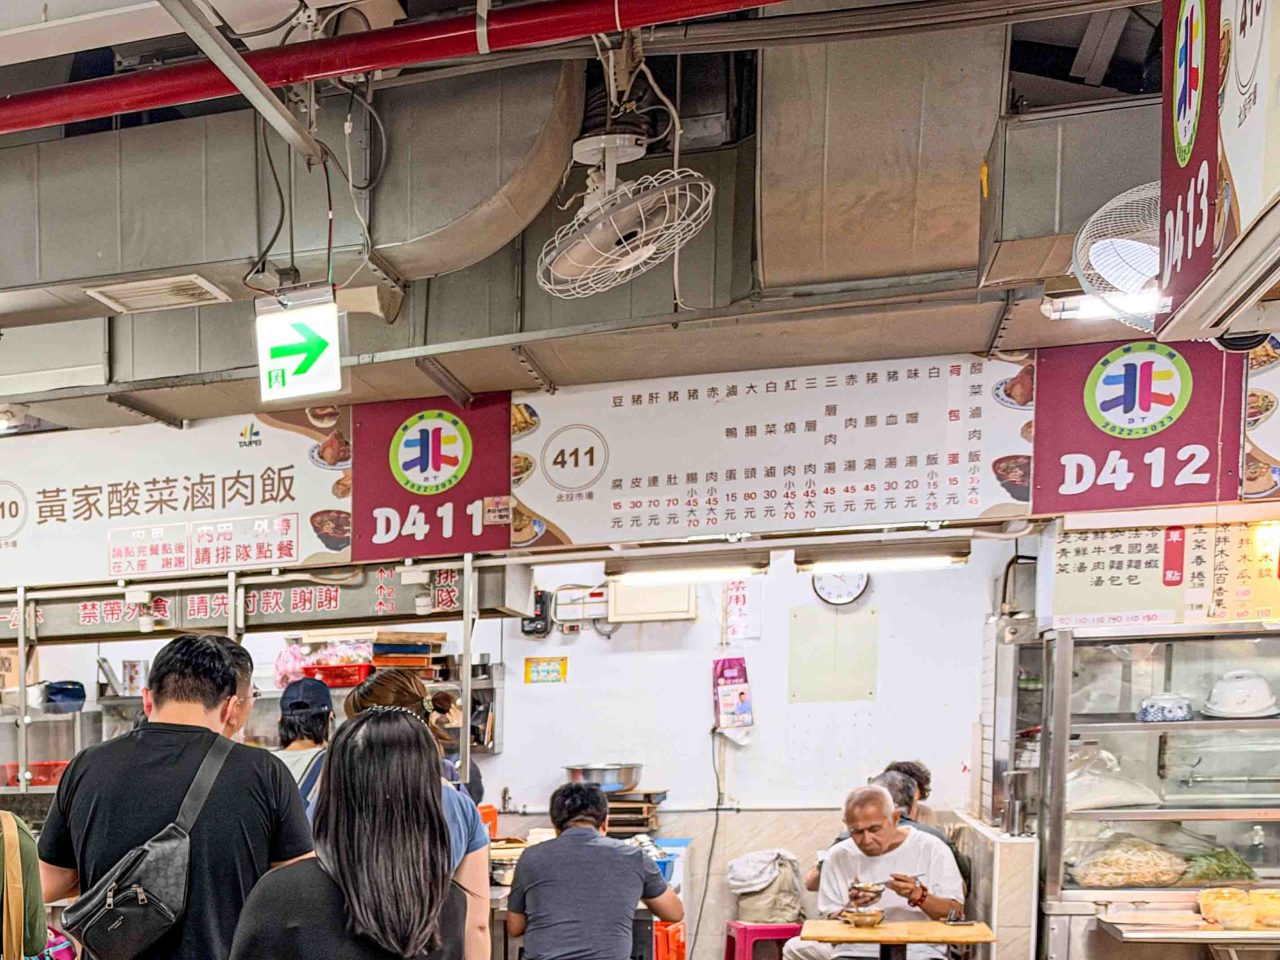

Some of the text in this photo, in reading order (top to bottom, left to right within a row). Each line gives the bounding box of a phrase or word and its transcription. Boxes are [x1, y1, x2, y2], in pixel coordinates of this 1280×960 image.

[1162, 159, 1209, 291] D413
[1102, 416, 1174, 435] 2022-2023
[552, 446, 595, 469] 411
[1058, 444, 1211, 495] D412
[36, 464, 296, 526] 黃家酸菜滷肉飯
[372, 499, 483, 544] D411
[194, 540, 294, 565] 請排隊點餐
[291, 587, 341, 612] 謝謝
